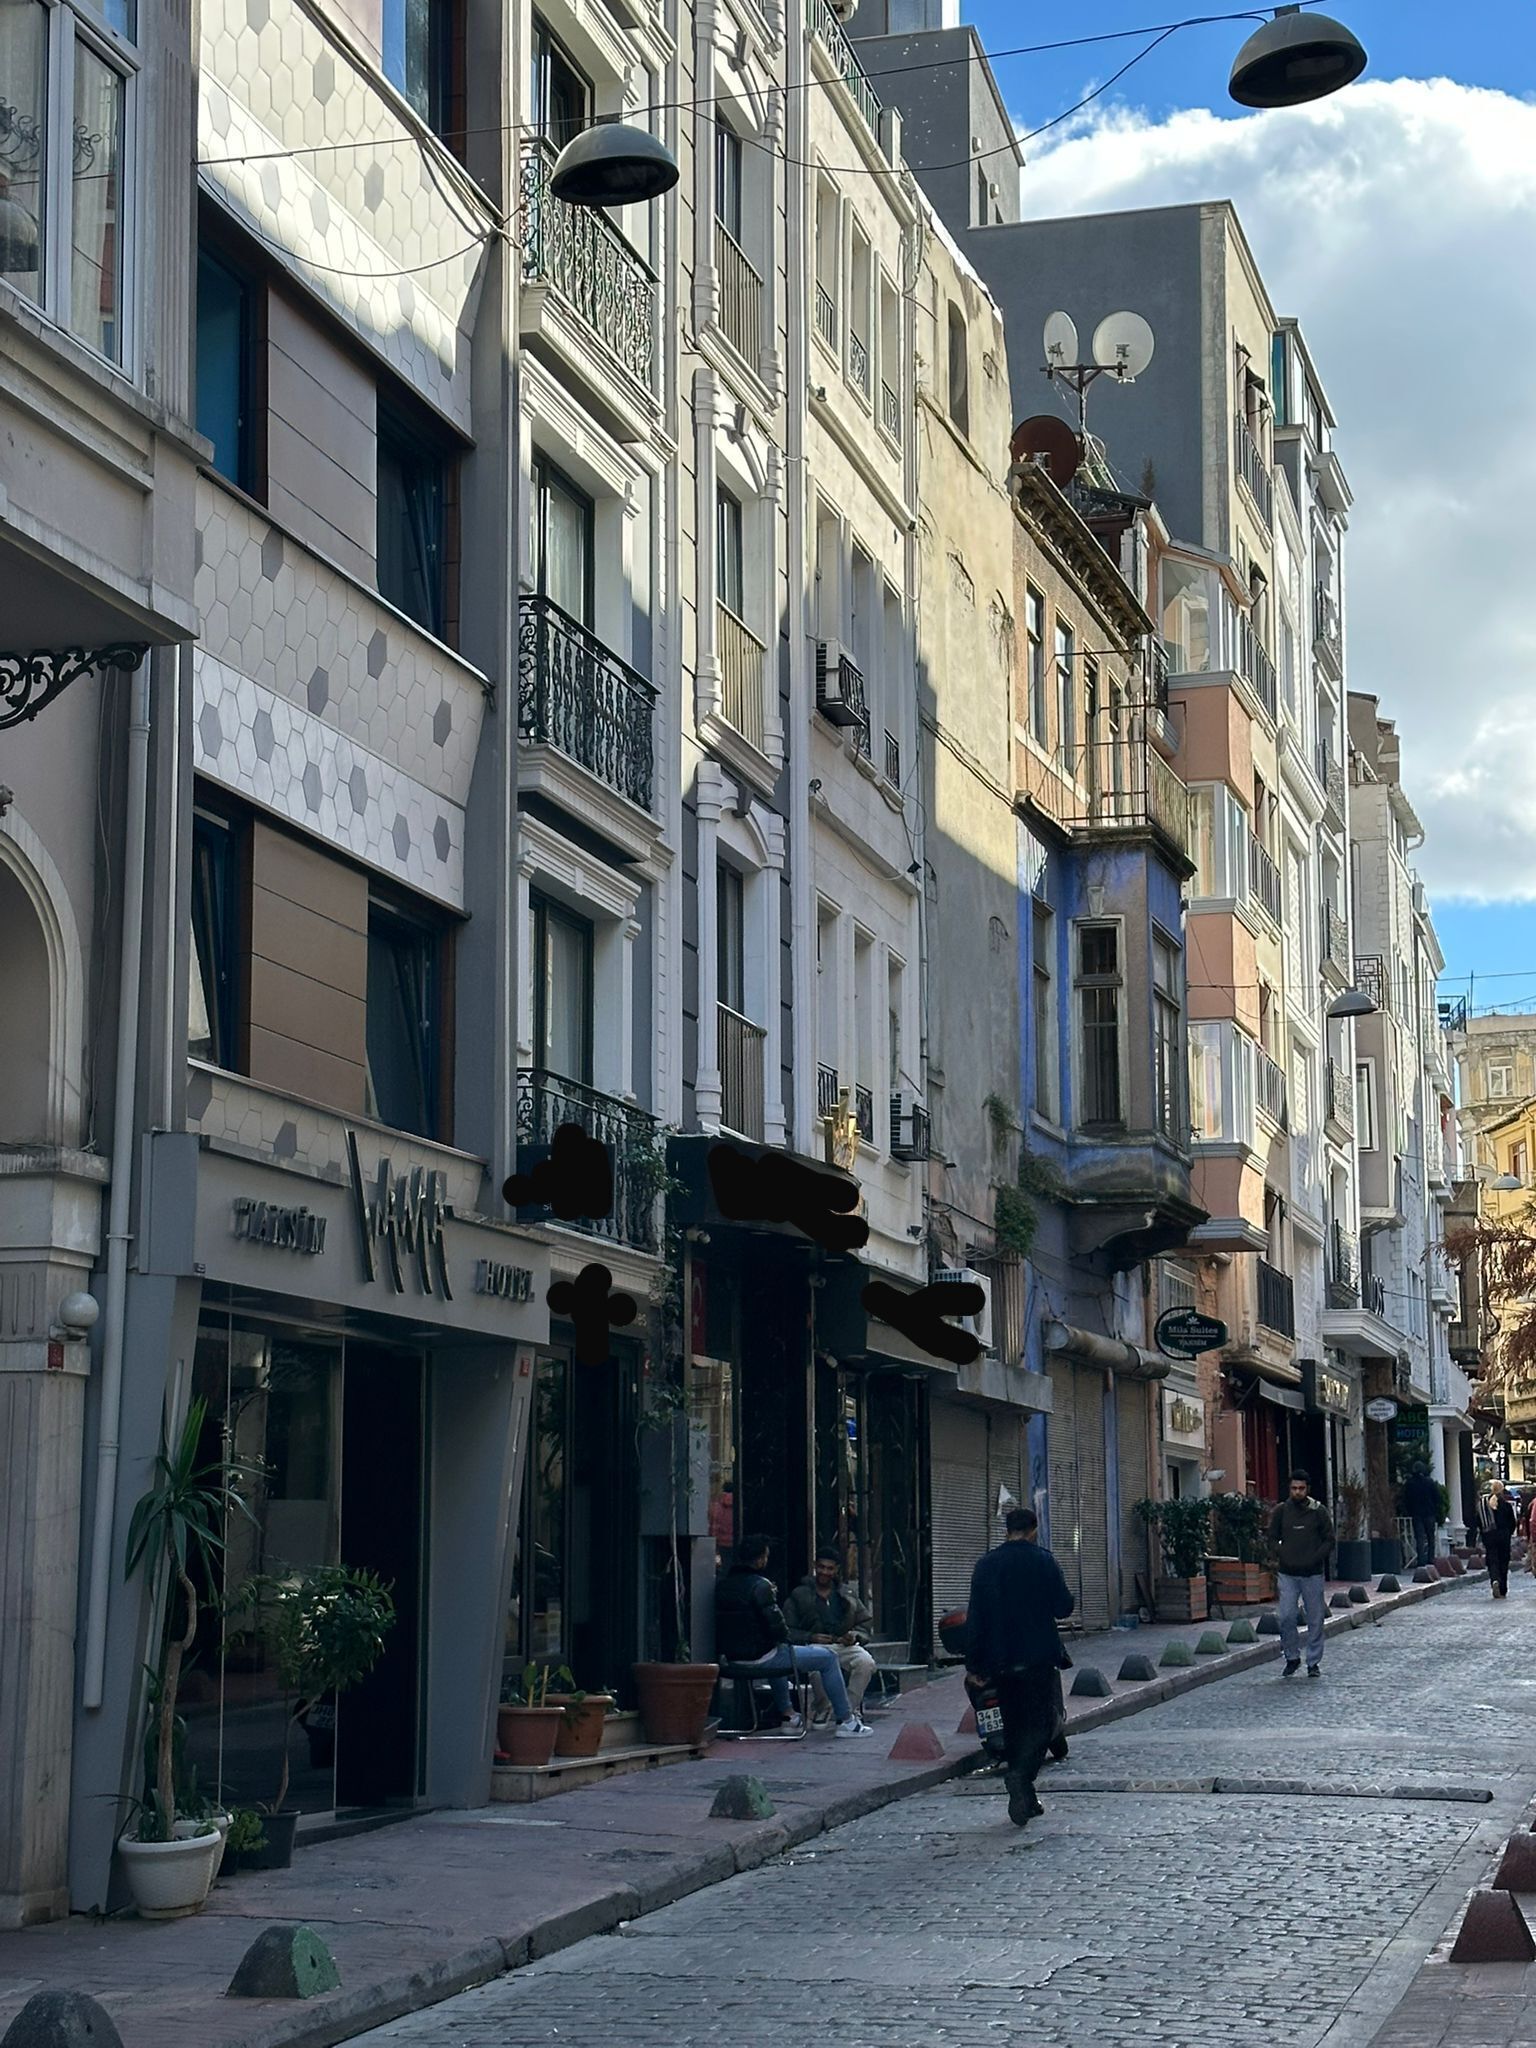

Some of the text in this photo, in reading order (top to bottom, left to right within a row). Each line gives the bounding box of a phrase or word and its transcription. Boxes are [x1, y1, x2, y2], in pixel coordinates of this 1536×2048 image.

[475, 1259, 535, 1303] HOTEL
[1168, 1326, 1219, 1334] Mila Suites
[1397, 1411, 1426, 1423] ABC
[978, 1711, 990, 1722] 34
